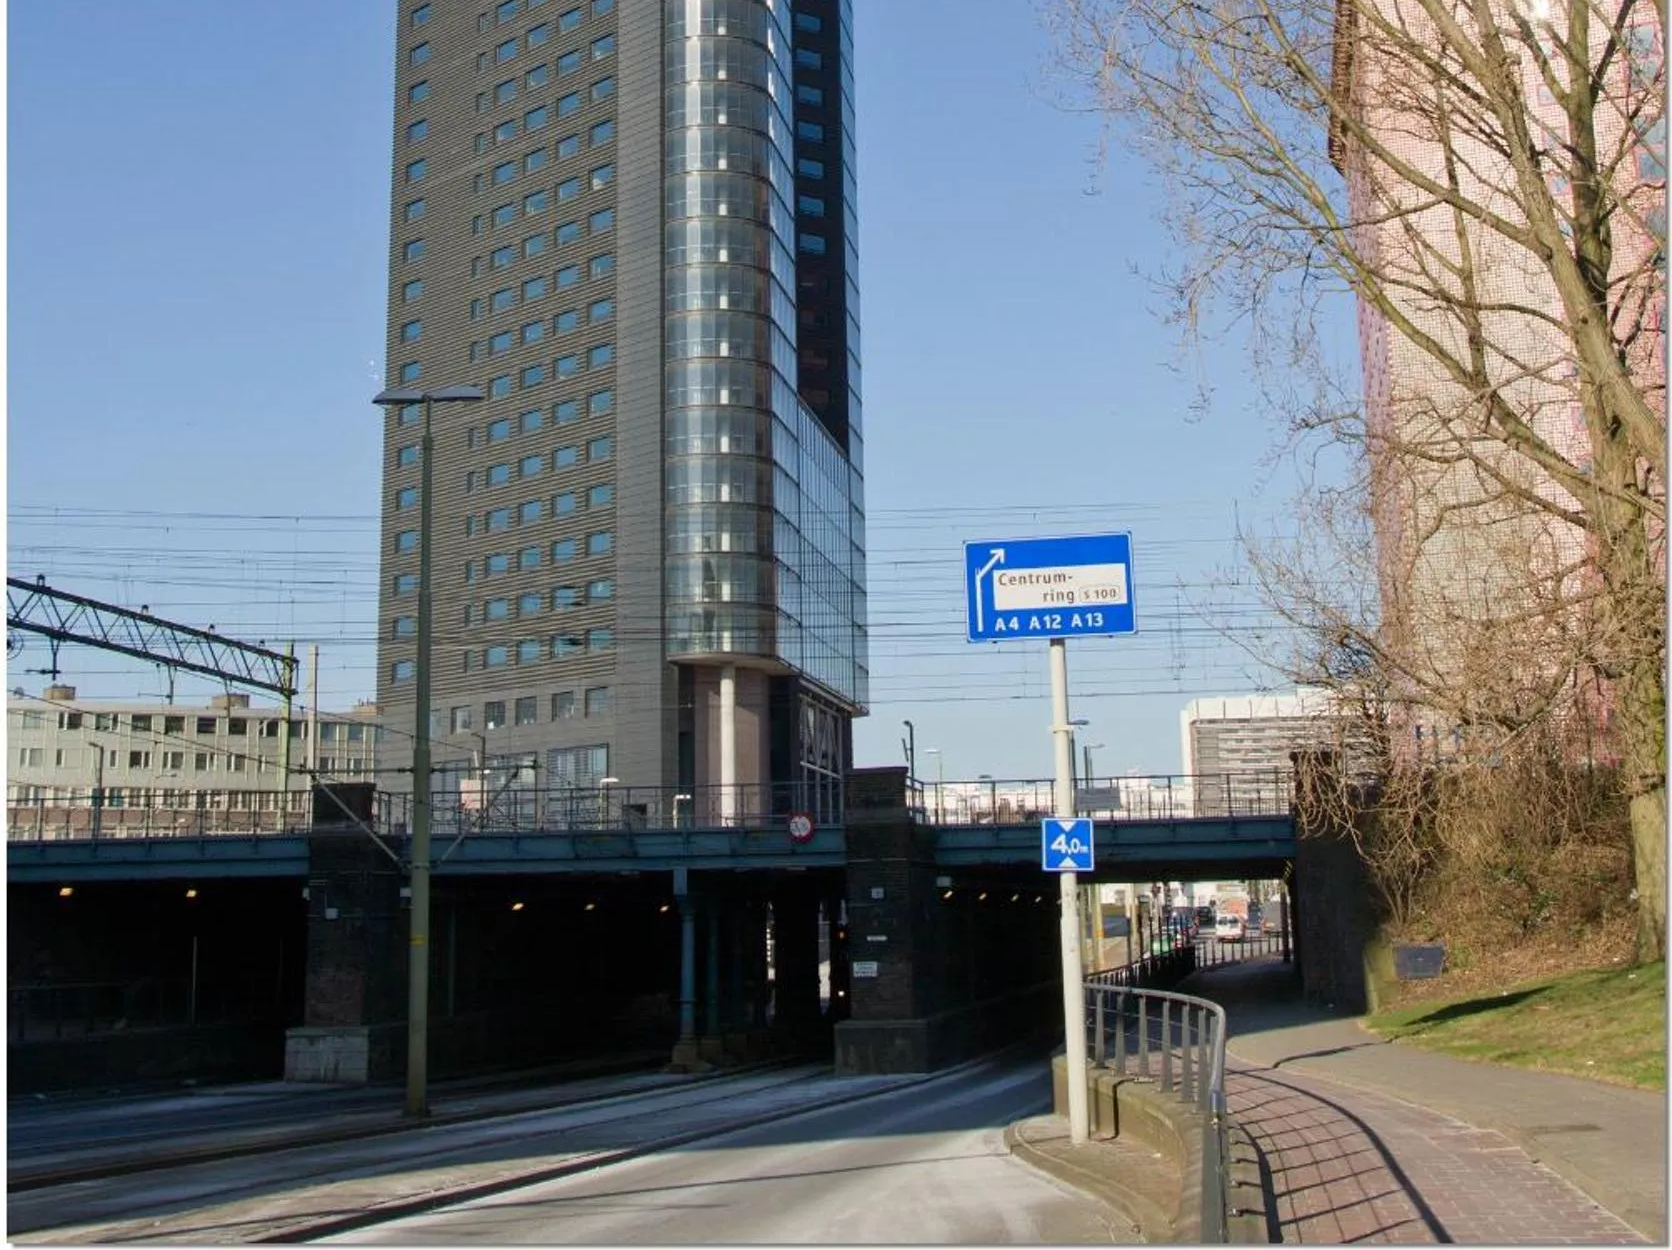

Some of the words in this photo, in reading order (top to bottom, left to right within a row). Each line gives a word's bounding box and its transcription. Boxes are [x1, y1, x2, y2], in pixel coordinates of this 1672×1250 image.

[998, 573, 1073, 586] Centrum-
[1042, 588, 1076, 604] ring
[1084, 590, 1091, 600] S
[1094, 588, 1117, 599] 100
[995, 617, 1019, 631] A4
[1029, 614, 1062, 630] A12
[1071, 612, 1104, 628] A13
